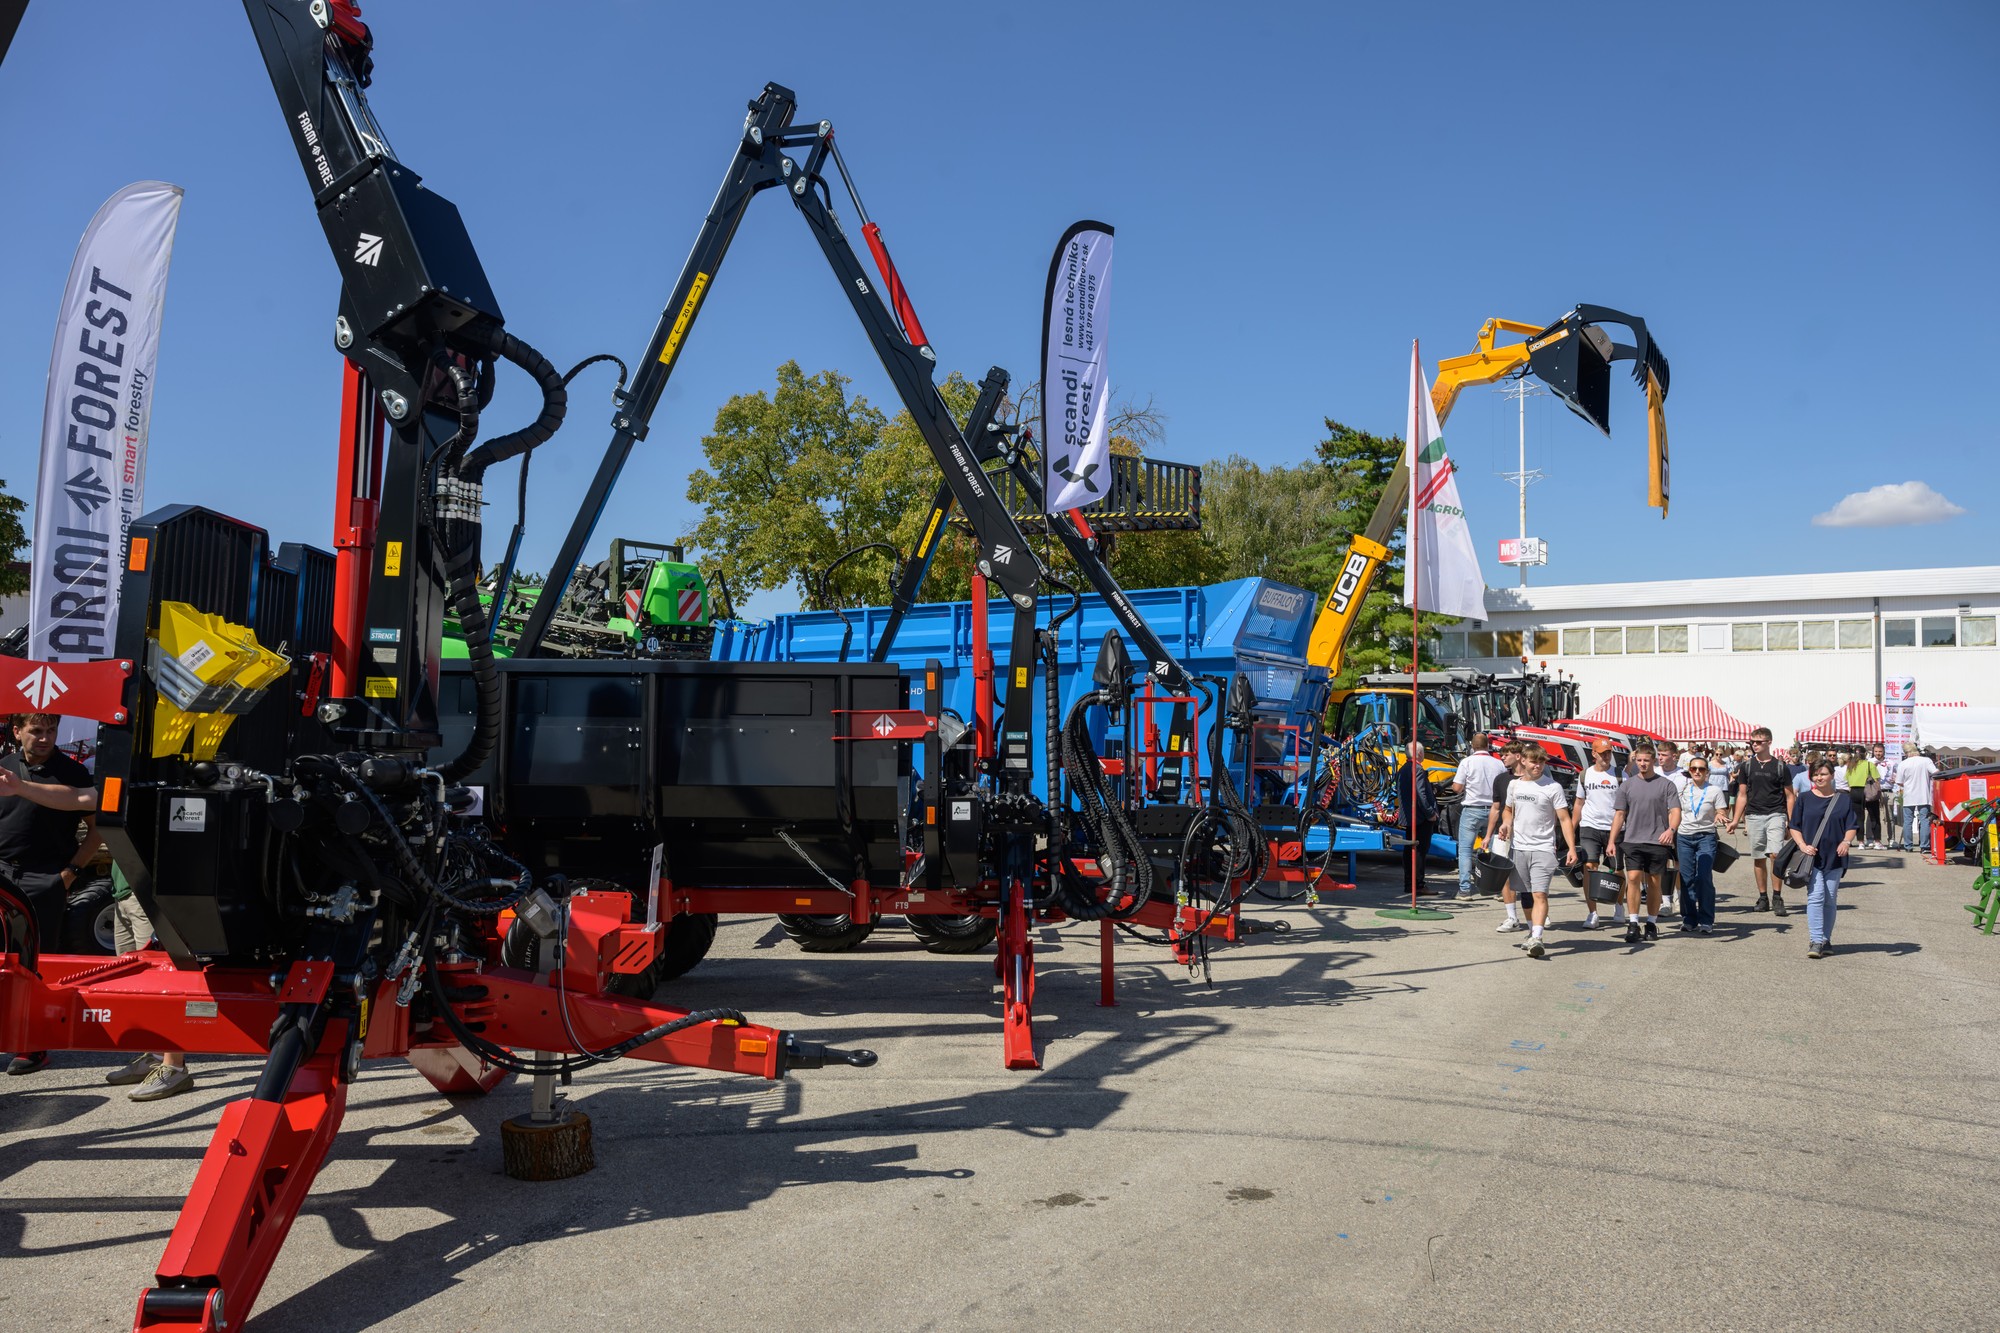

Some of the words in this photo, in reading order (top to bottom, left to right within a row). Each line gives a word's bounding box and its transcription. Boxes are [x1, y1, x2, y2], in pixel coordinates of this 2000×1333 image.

[297, 110, 318, 146] FARMI
[1065, 242, 1079, 304] technika
[1078, 243, 1089, 349] www.scandiforest.sk
[682, 308, 690, 318] 20
[687, 300, 694, 308] M
[1063, 306, 1074, 347] lesná
[67, 265, 132, 460] FOREST
[124, 367, 149, 433] forestry
[1061, 368, 1078, 446] scandi
[1077, 381, 1093, 448] forest
[122, 435, 138, 484] smart
[949, 443, 967, 467] FARMI
[965, 471, 985, 498] FOREST
[118, 487, 134, 506] in
[47, 526, 112, 662] ARMI
[1261, 590, 1293, 609] BUFFALO
[1332, 553, 1368, 613] JCB
[648, 639, 658, 650] 40
[895, 901, 909, 910] FT9
[82, 1008, 112, 1023] FT12
